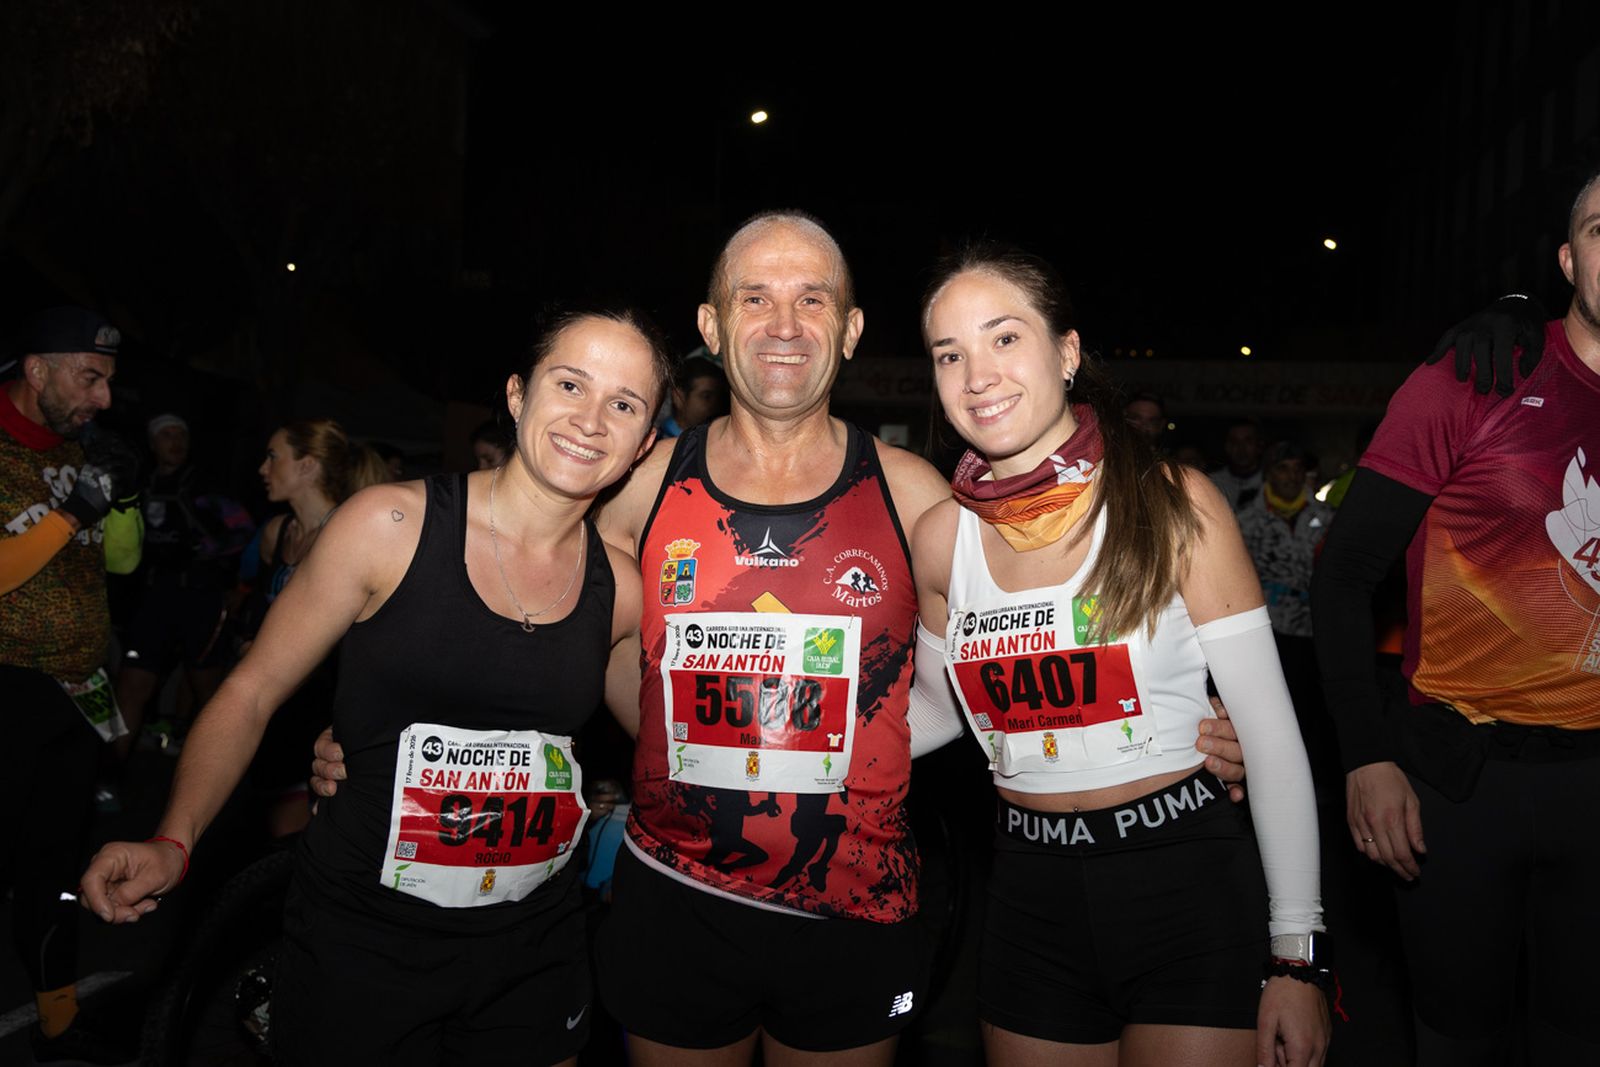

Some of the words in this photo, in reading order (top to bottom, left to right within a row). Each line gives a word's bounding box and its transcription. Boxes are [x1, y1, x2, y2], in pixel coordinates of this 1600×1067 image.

[734, 555, 799, 568] Vulkano
[833, 549, 889, 591] CORRECAMINOS
[831, 586, 883, 608] Martos
[1017, 601, 1054, 611] INTERNACIONAL
[963, 617, 976, 630] 43
[978, 612, 1030, 634] NOCHE
[1035, 608, 1054, 627] DE
[685, 629, 704, 642] 43
[707, 633, 762, 650] NOCHE
[765, 634, 786, 650] DE
[960, 638, 991, 660] SAN
[995, 628, 1056, 656] ANTÓN
[682, 654, 720, 670] SAN
[721, 650, 785, 672] ANTÓN
[980, 652, 1097, 714] 6407
[1008, 716, 1034, 730] Mari
[1038, 712, 1083, 726] Carmen
[422, 741, 443, 756] 43
[493, 741, 531, 749] INTERNACIONAL
[446, 749, 505, 766] NOCHE
[510, 750, 531, 767] DE
[420, 768, 462, 790] SAN
[464, 767, 530, 790] ANTÓN
[1008, 807, 1096, 845] PUMA
[1114, 777, 1216, 839] PUMA
[438, 795, 556, 848] 9414
[474, 852, 512, 864] ROCIO
